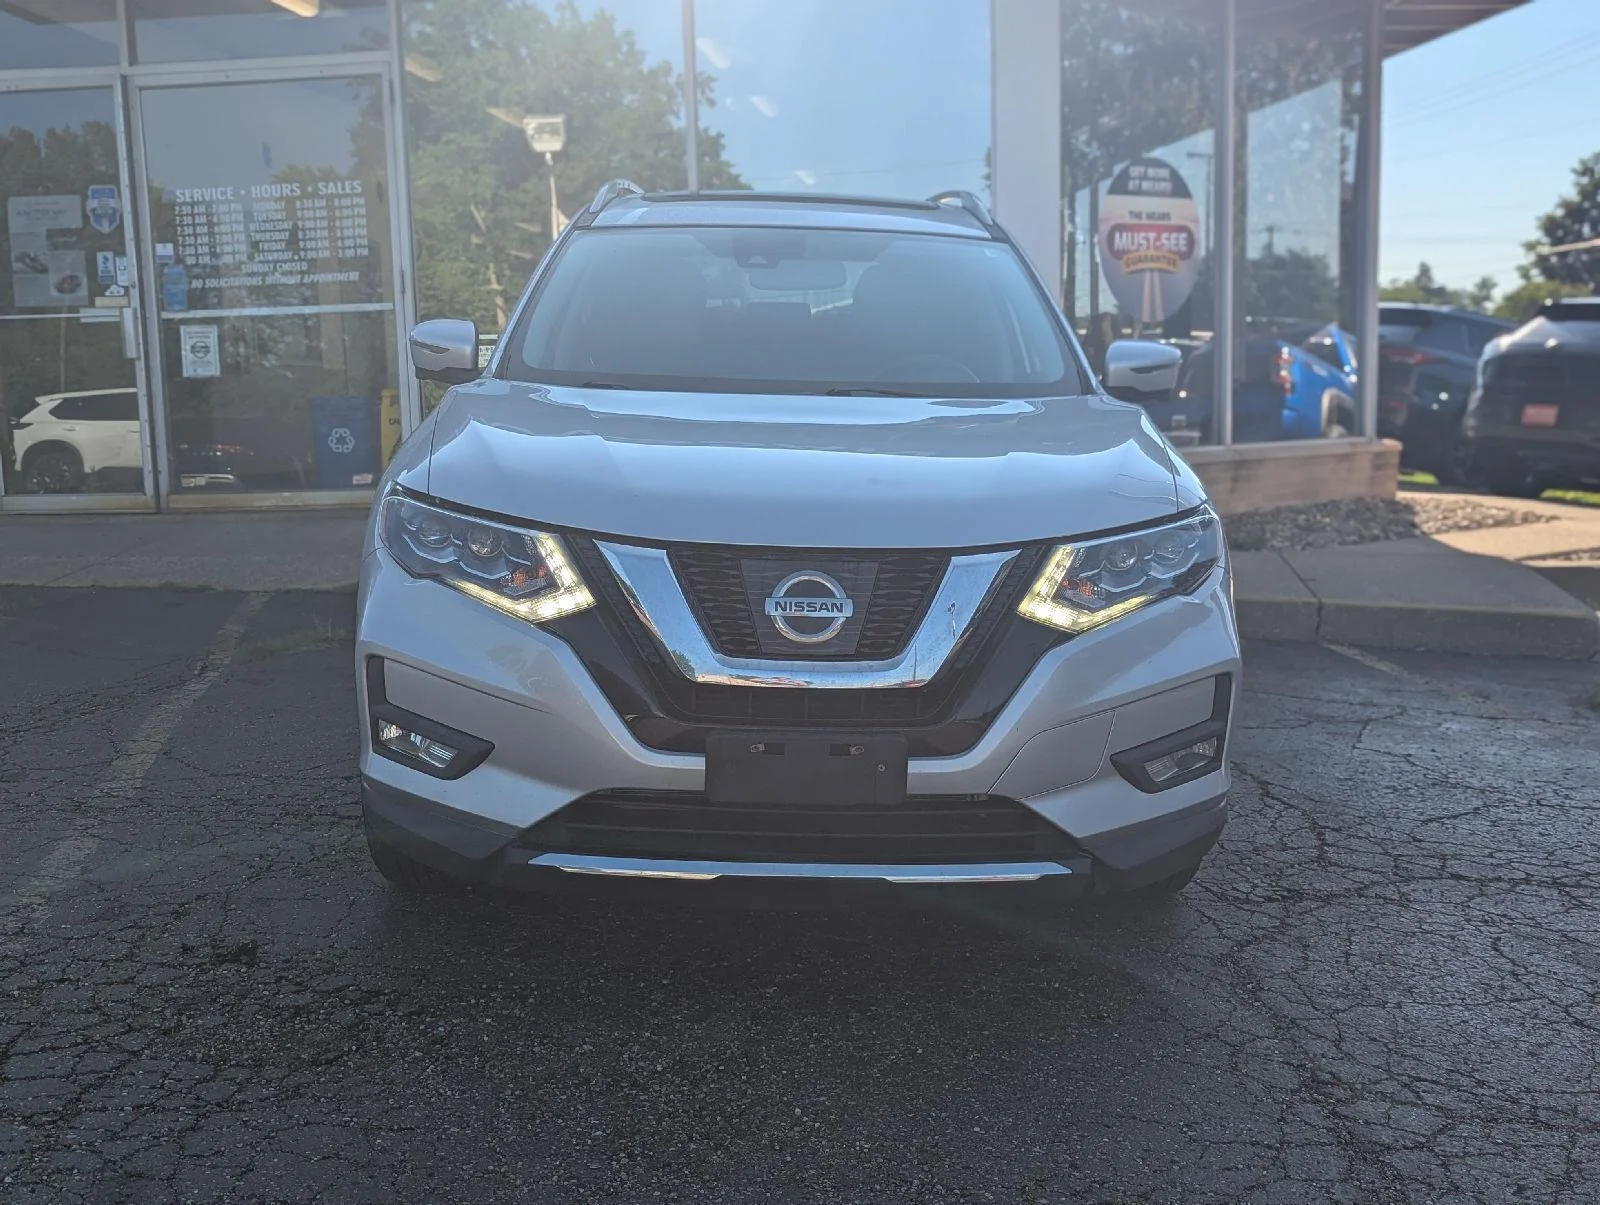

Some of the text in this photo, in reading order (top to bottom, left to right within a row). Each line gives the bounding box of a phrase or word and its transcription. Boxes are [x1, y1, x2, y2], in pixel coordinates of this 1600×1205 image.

[176, 180, 362, 203] SERVICE HOURS SALES
[193, 204, 206, 213] AM
[352, 196, 365, 205] PM
[175, 216, 193, 224] 7:30
[194, 214, 207, 223] AM
[315, 209, 327, 217] AM
[353, 207, 366, 215] PM
[1128, 210, 1143, 221] THE
[177, 226, 194, 235] 7:30
[196, 225, 208, 234] AM
[249, 221, 292, 230] WEDNESDAY
[354, 217, 367, 226] PM
[178, 236, 195, 244] 7:30
[197, 235, 209, 244] AM
[251, 231, 290, 241] THURSDAY
[355, 227, 367, 236] PM
[1114, 231, 1188, 252] MUST-SEE
[197, 245, 210, 254] AM
[259, 241, 286, 251] FRIDAY
[317, 238, 329, 248] AM
[356, 237, 368, 246] PM
[254, 251, 293, 262] SATURDAY
[318, 249, 331, 258] AM
[356, 247, 369, 256] PM
[1124, 253, 1178, 269] GUARANTEE
[241, 261, 308, 273] SUNDAY CLOSED
[190, 271, 360, 288] NO SOLICITATIONS WITHOUT APPOINTMENT
[774, 601, 844, 613] NISSAN
